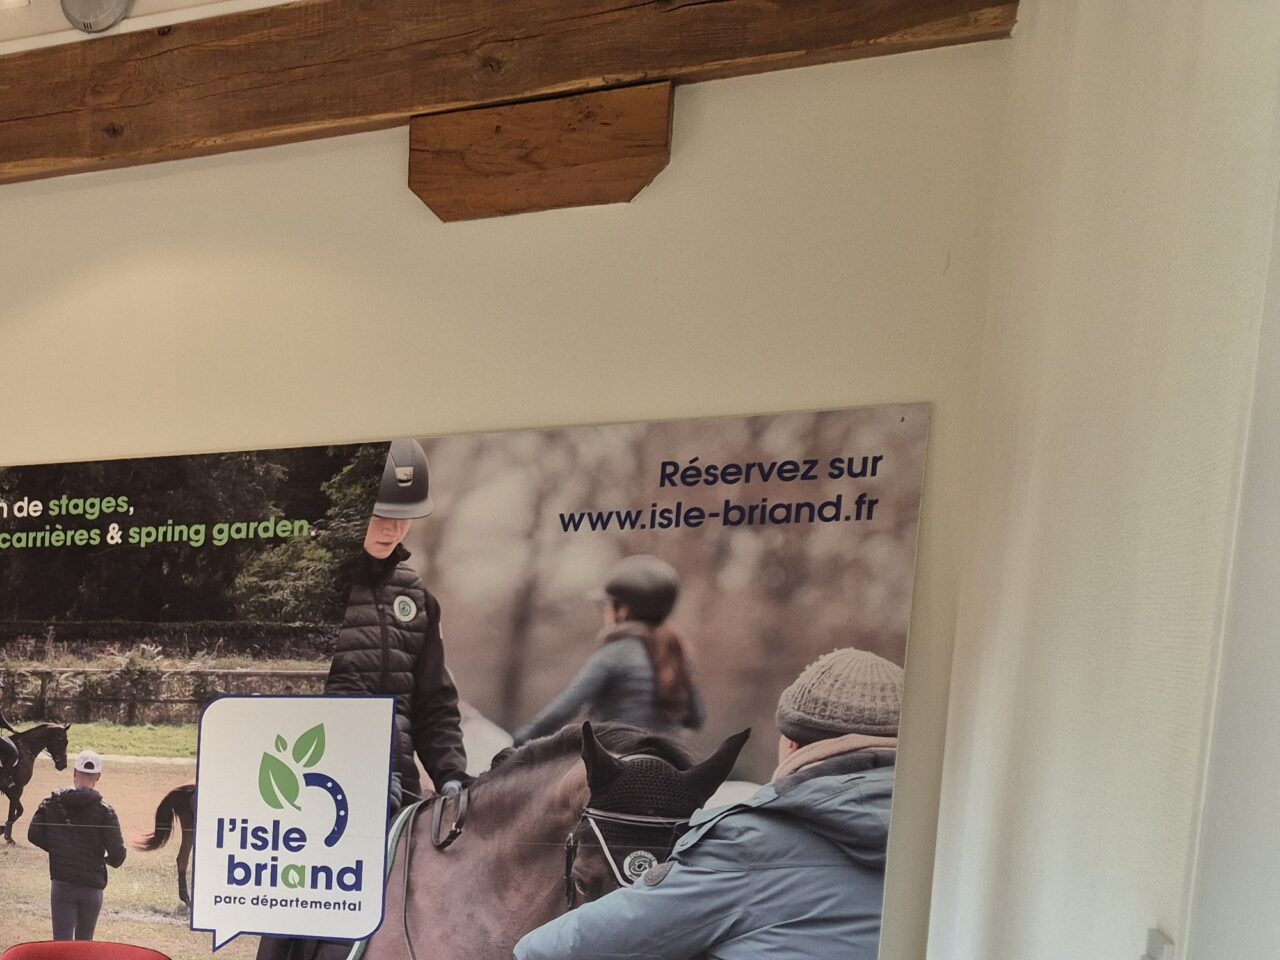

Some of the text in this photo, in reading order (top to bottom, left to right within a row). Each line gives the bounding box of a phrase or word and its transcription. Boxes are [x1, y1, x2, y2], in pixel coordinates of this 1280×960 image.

[659, 455, 883, 488] Réservez sur
[13, 497, 43, 518] de
[48, 494, 134, 520] stages,
[559, 493, 879, 533] www.isle-briand.fr
[106, 523, 122, 545] &
[128, 518, 206, 548] spring
[216, 817, 308, 852] l'isle
[227, 854, 364, 892] briand
[214, 894, 362, 911] parc départemental
